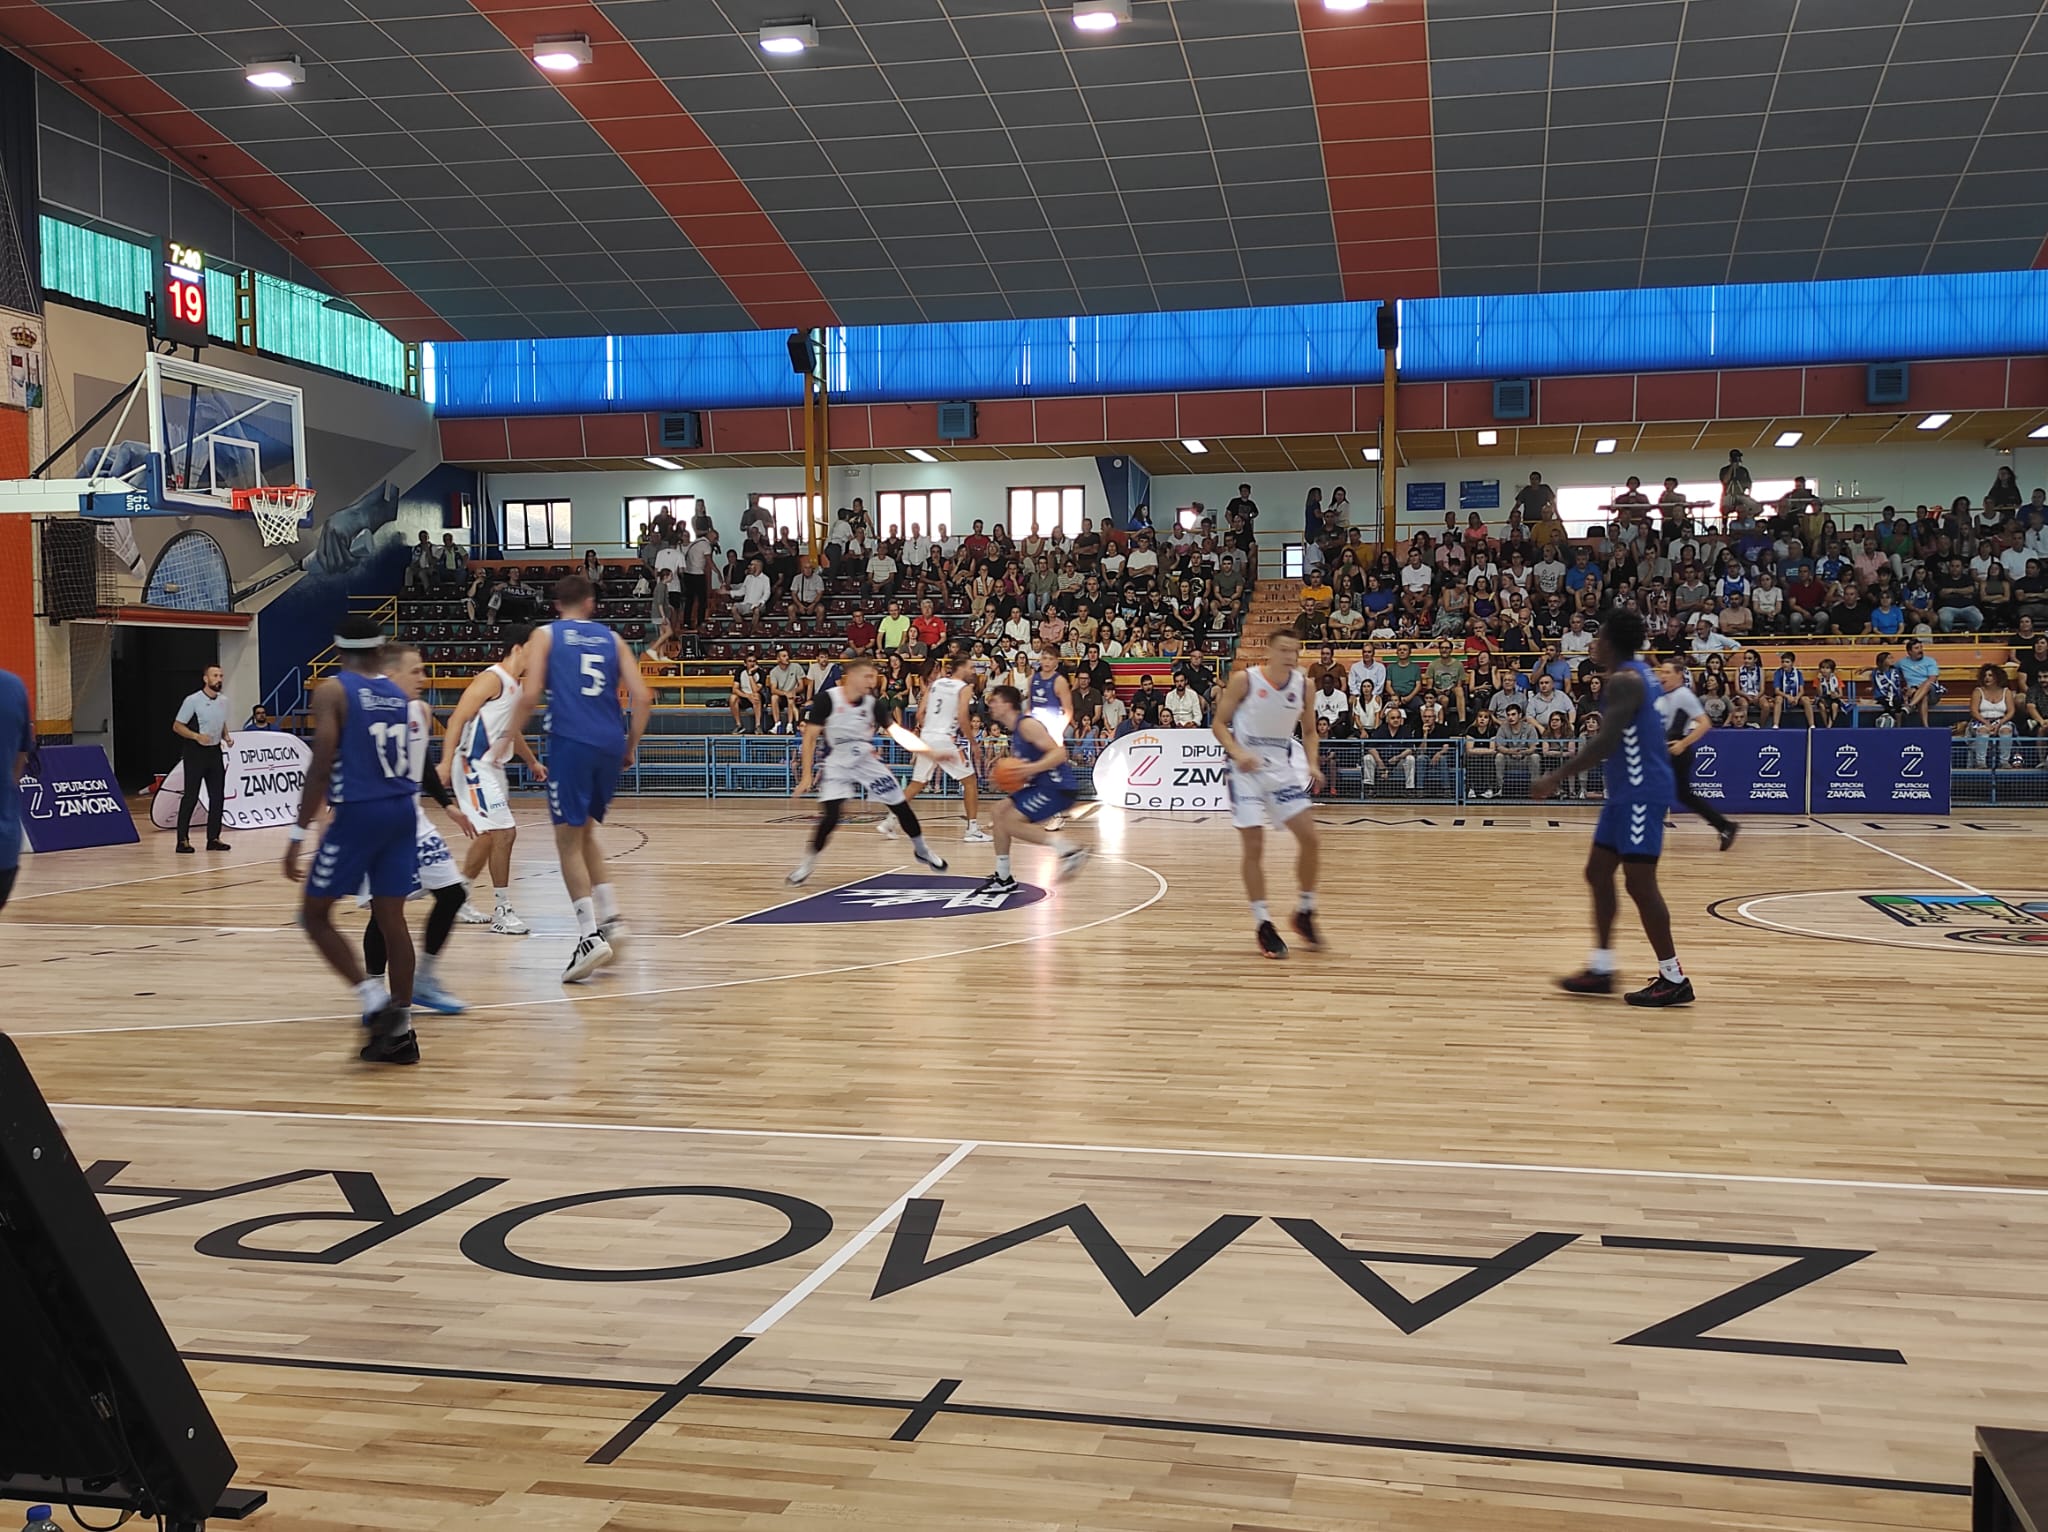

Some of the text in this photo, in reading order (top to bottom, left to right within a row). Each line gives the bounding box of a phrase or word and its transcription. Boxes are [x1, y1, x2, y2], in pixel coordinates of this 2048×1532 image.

[169, 281, 202, 323] 19
[580, 653, 607, 697] 5
[368, 722, 409, 779] 11
[54, 796, 122, 817] ZAMORA
[1749, 790, 1789, 799] ZAMORA
[1826, 790, 1867, 799] ZAMORA
[1891, 790, 1932, 799] ZAMORA
[221, 802, 302, 826] Deport
[82, 1158, 1908, 1365] ZAMORA
